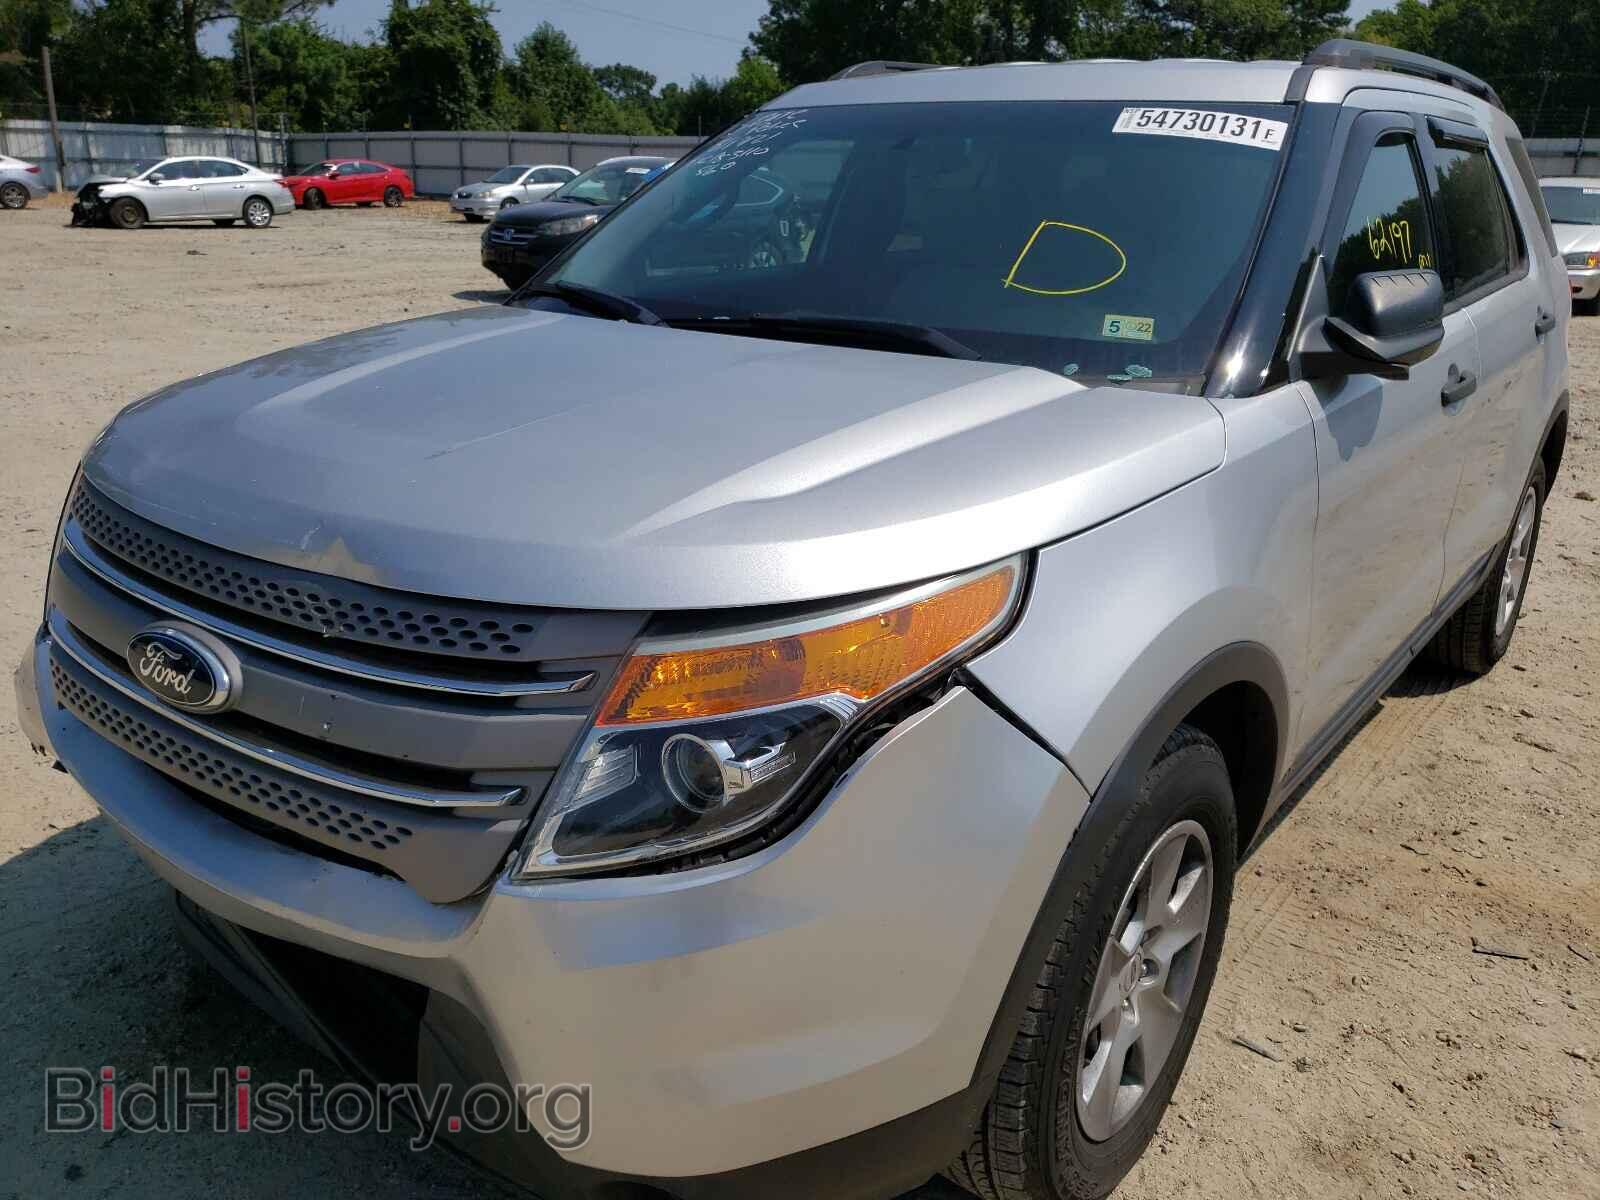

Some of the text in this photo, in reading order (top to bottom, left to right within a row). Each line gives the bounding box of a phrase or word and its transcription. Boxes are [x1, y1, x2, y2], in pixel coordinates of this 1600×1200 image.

[1137, 109, 1262, 140] 54730131
[1109, 320, 1121, 333] 5
[1136, 322, 1152, 333] 22
[140, 641, 196, 695] Ford
